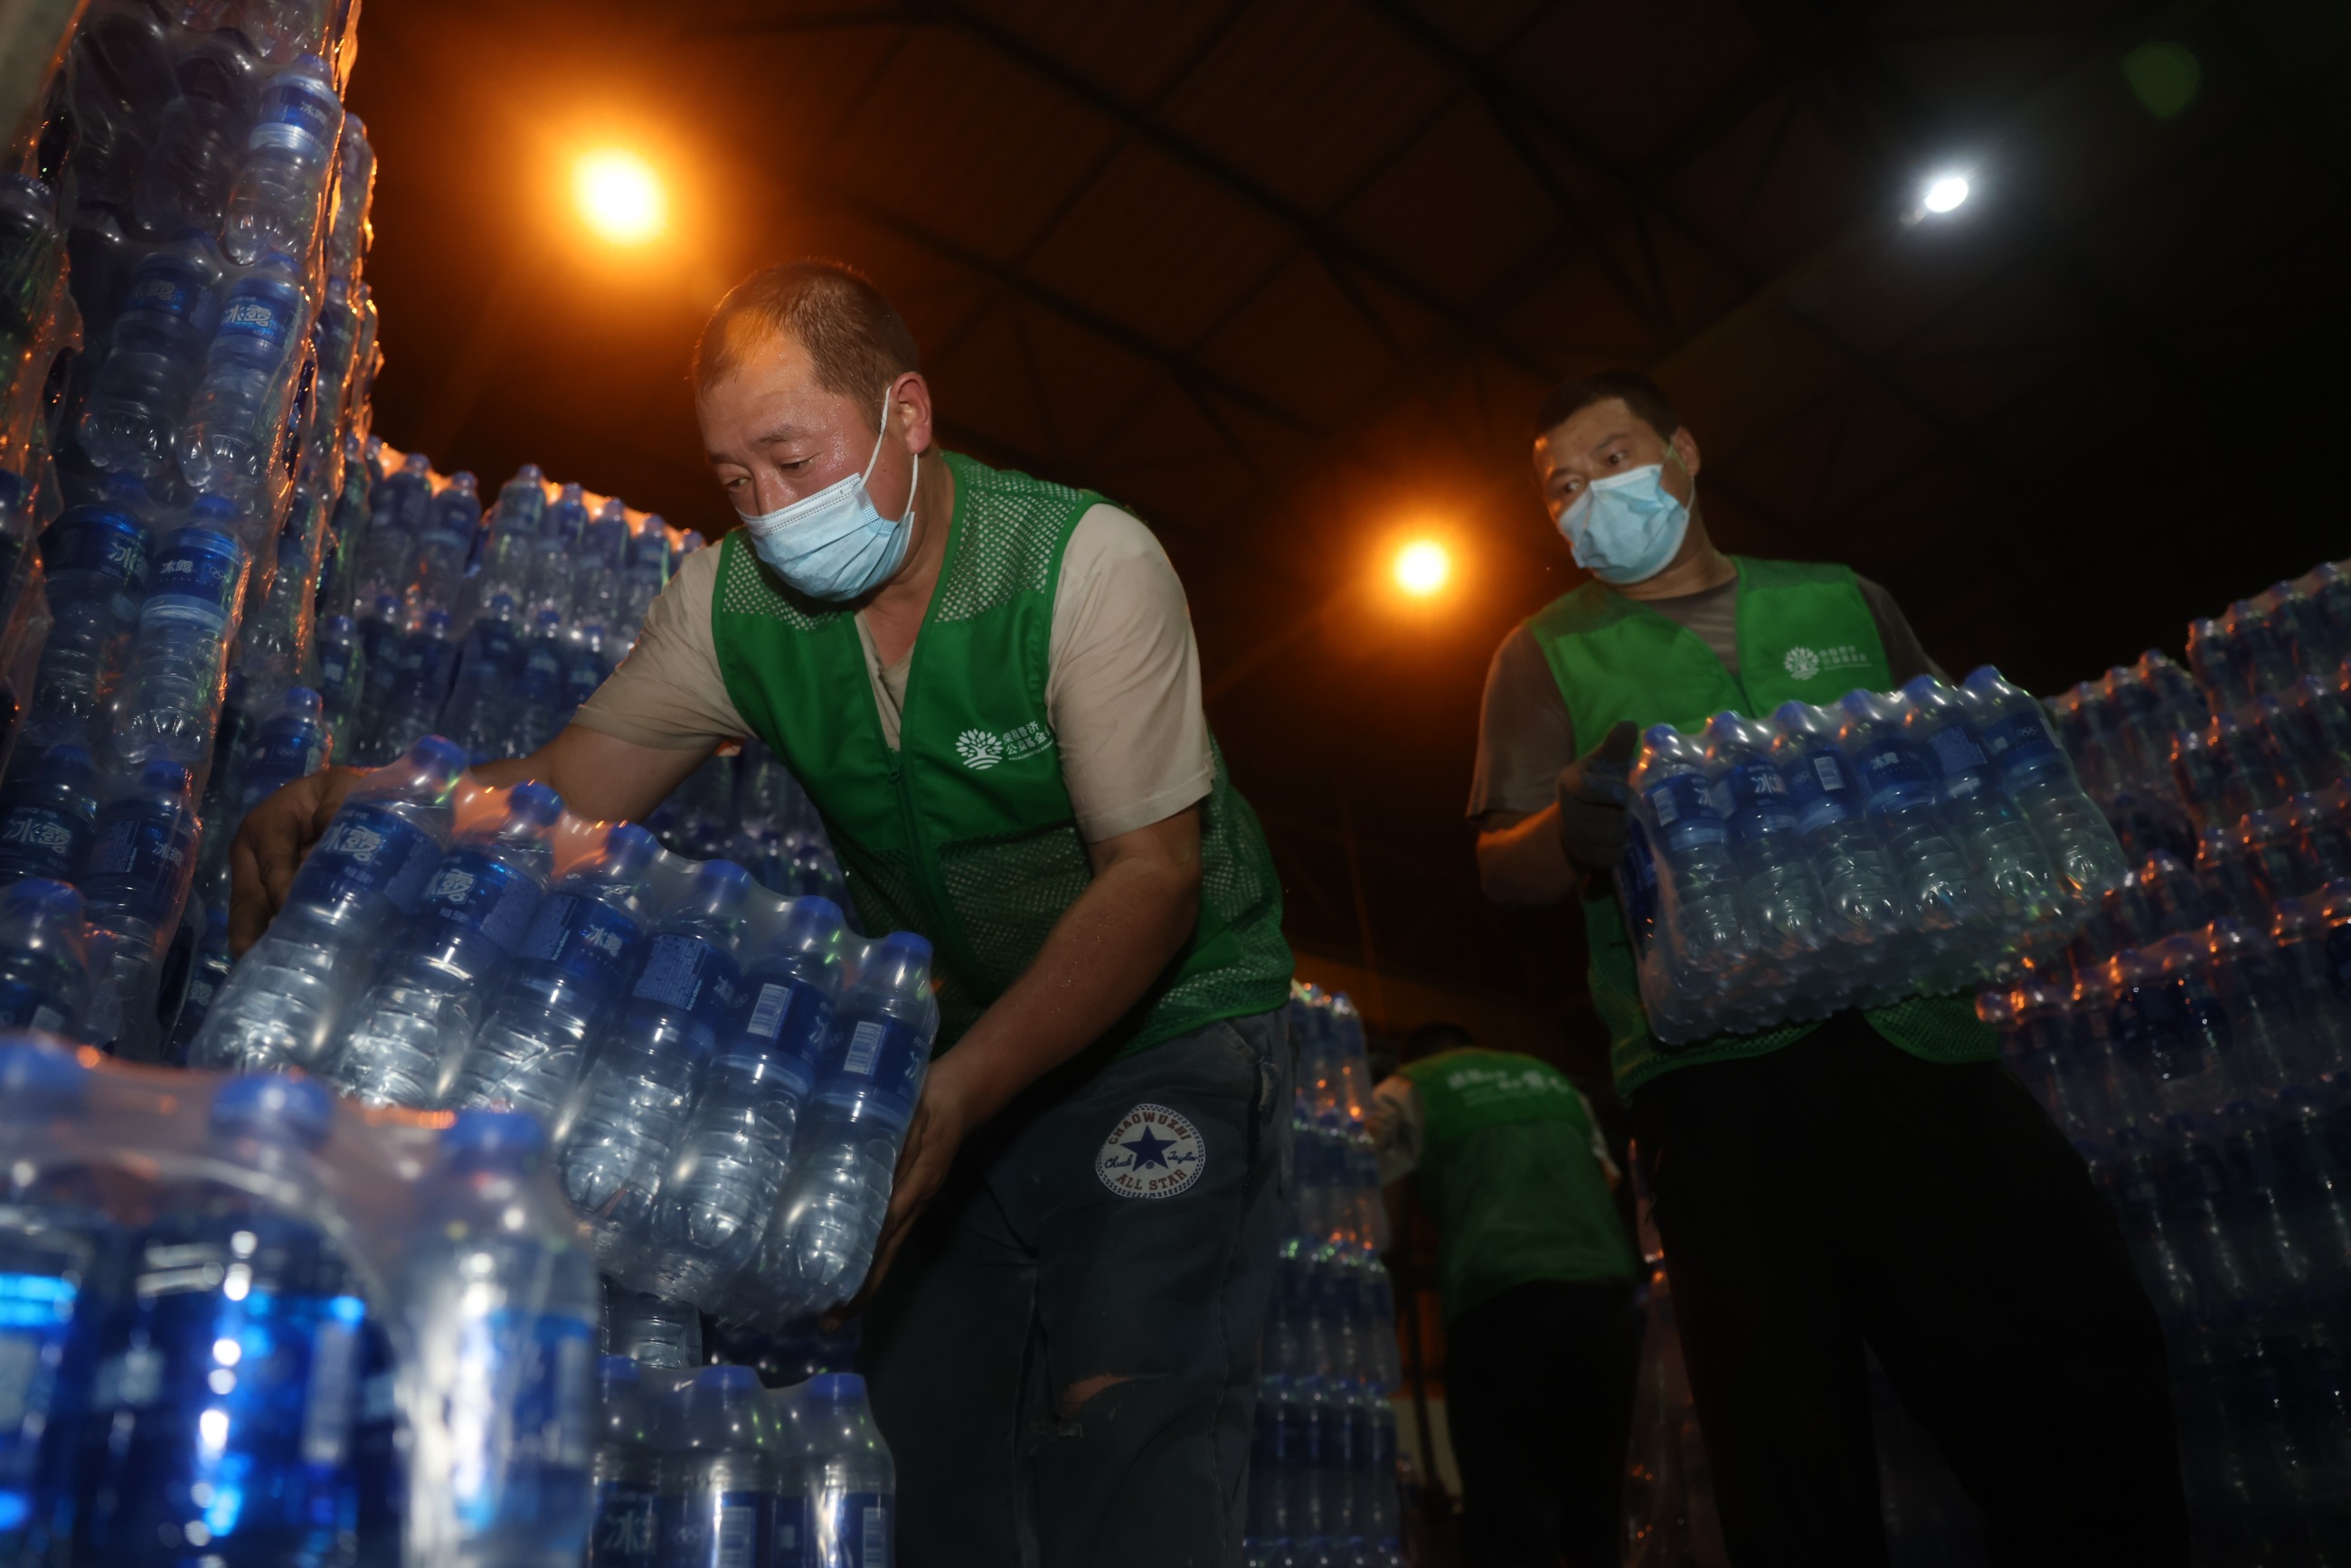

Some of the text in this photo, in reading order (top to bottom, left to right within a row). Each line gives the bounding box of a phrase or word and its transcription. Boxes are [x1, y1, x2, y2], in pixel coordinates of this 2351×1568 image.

[222, 304, 272, 328] 冰露
[160, 559, 194, 574] 冰露
[3, 817, 72, 855] 冰露
[1108, 1111, 1192, 1145] CHAOWUZHI
[1115, 1168, 1188, 1191] ALL STAR
